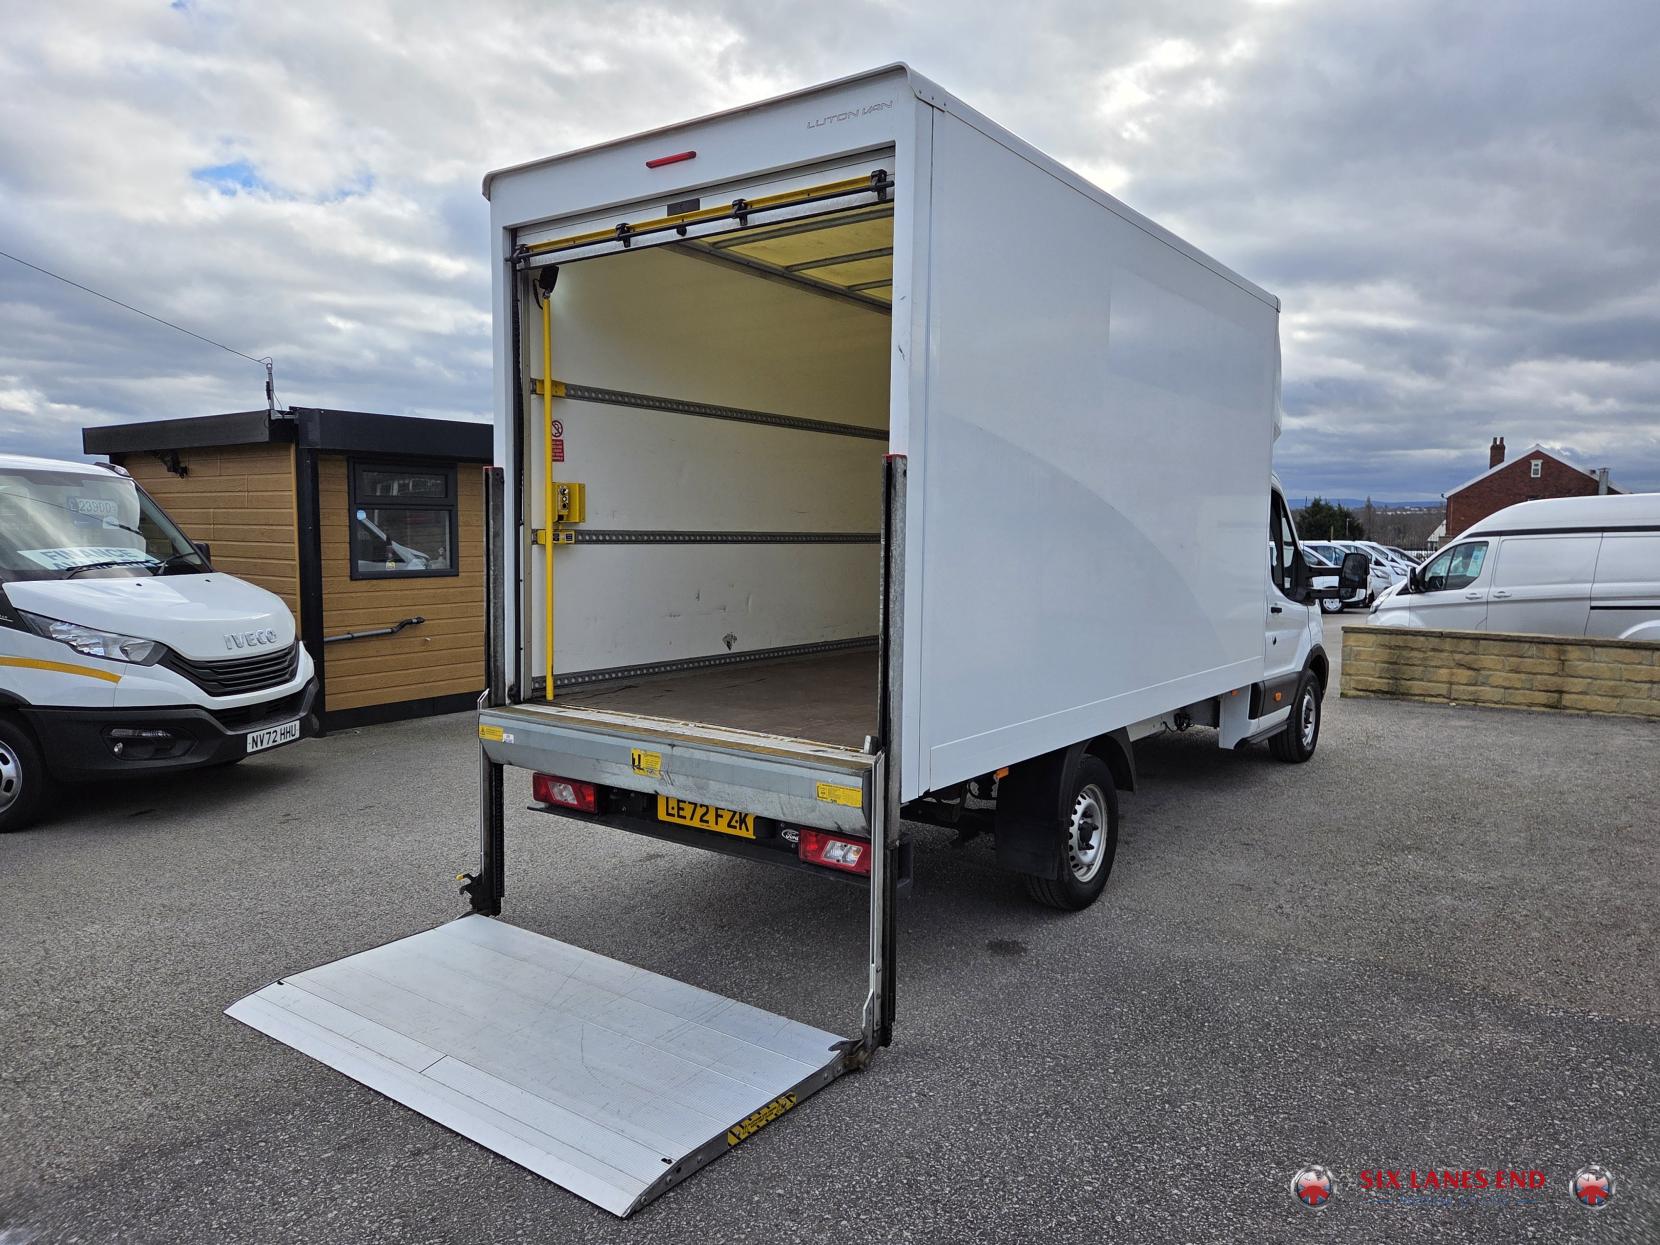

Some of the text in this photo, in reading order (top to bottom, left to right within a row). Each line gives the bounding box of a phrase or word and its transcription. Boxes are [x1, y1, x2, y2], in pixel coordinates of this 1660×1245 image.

[806, 100, 893, 129] LUTON VAN
[223, 628, 277, 650] IVECO
[251, 723, 297, 750] NV72 HHU
[665, 796, 750, 832] LE72 FZK
